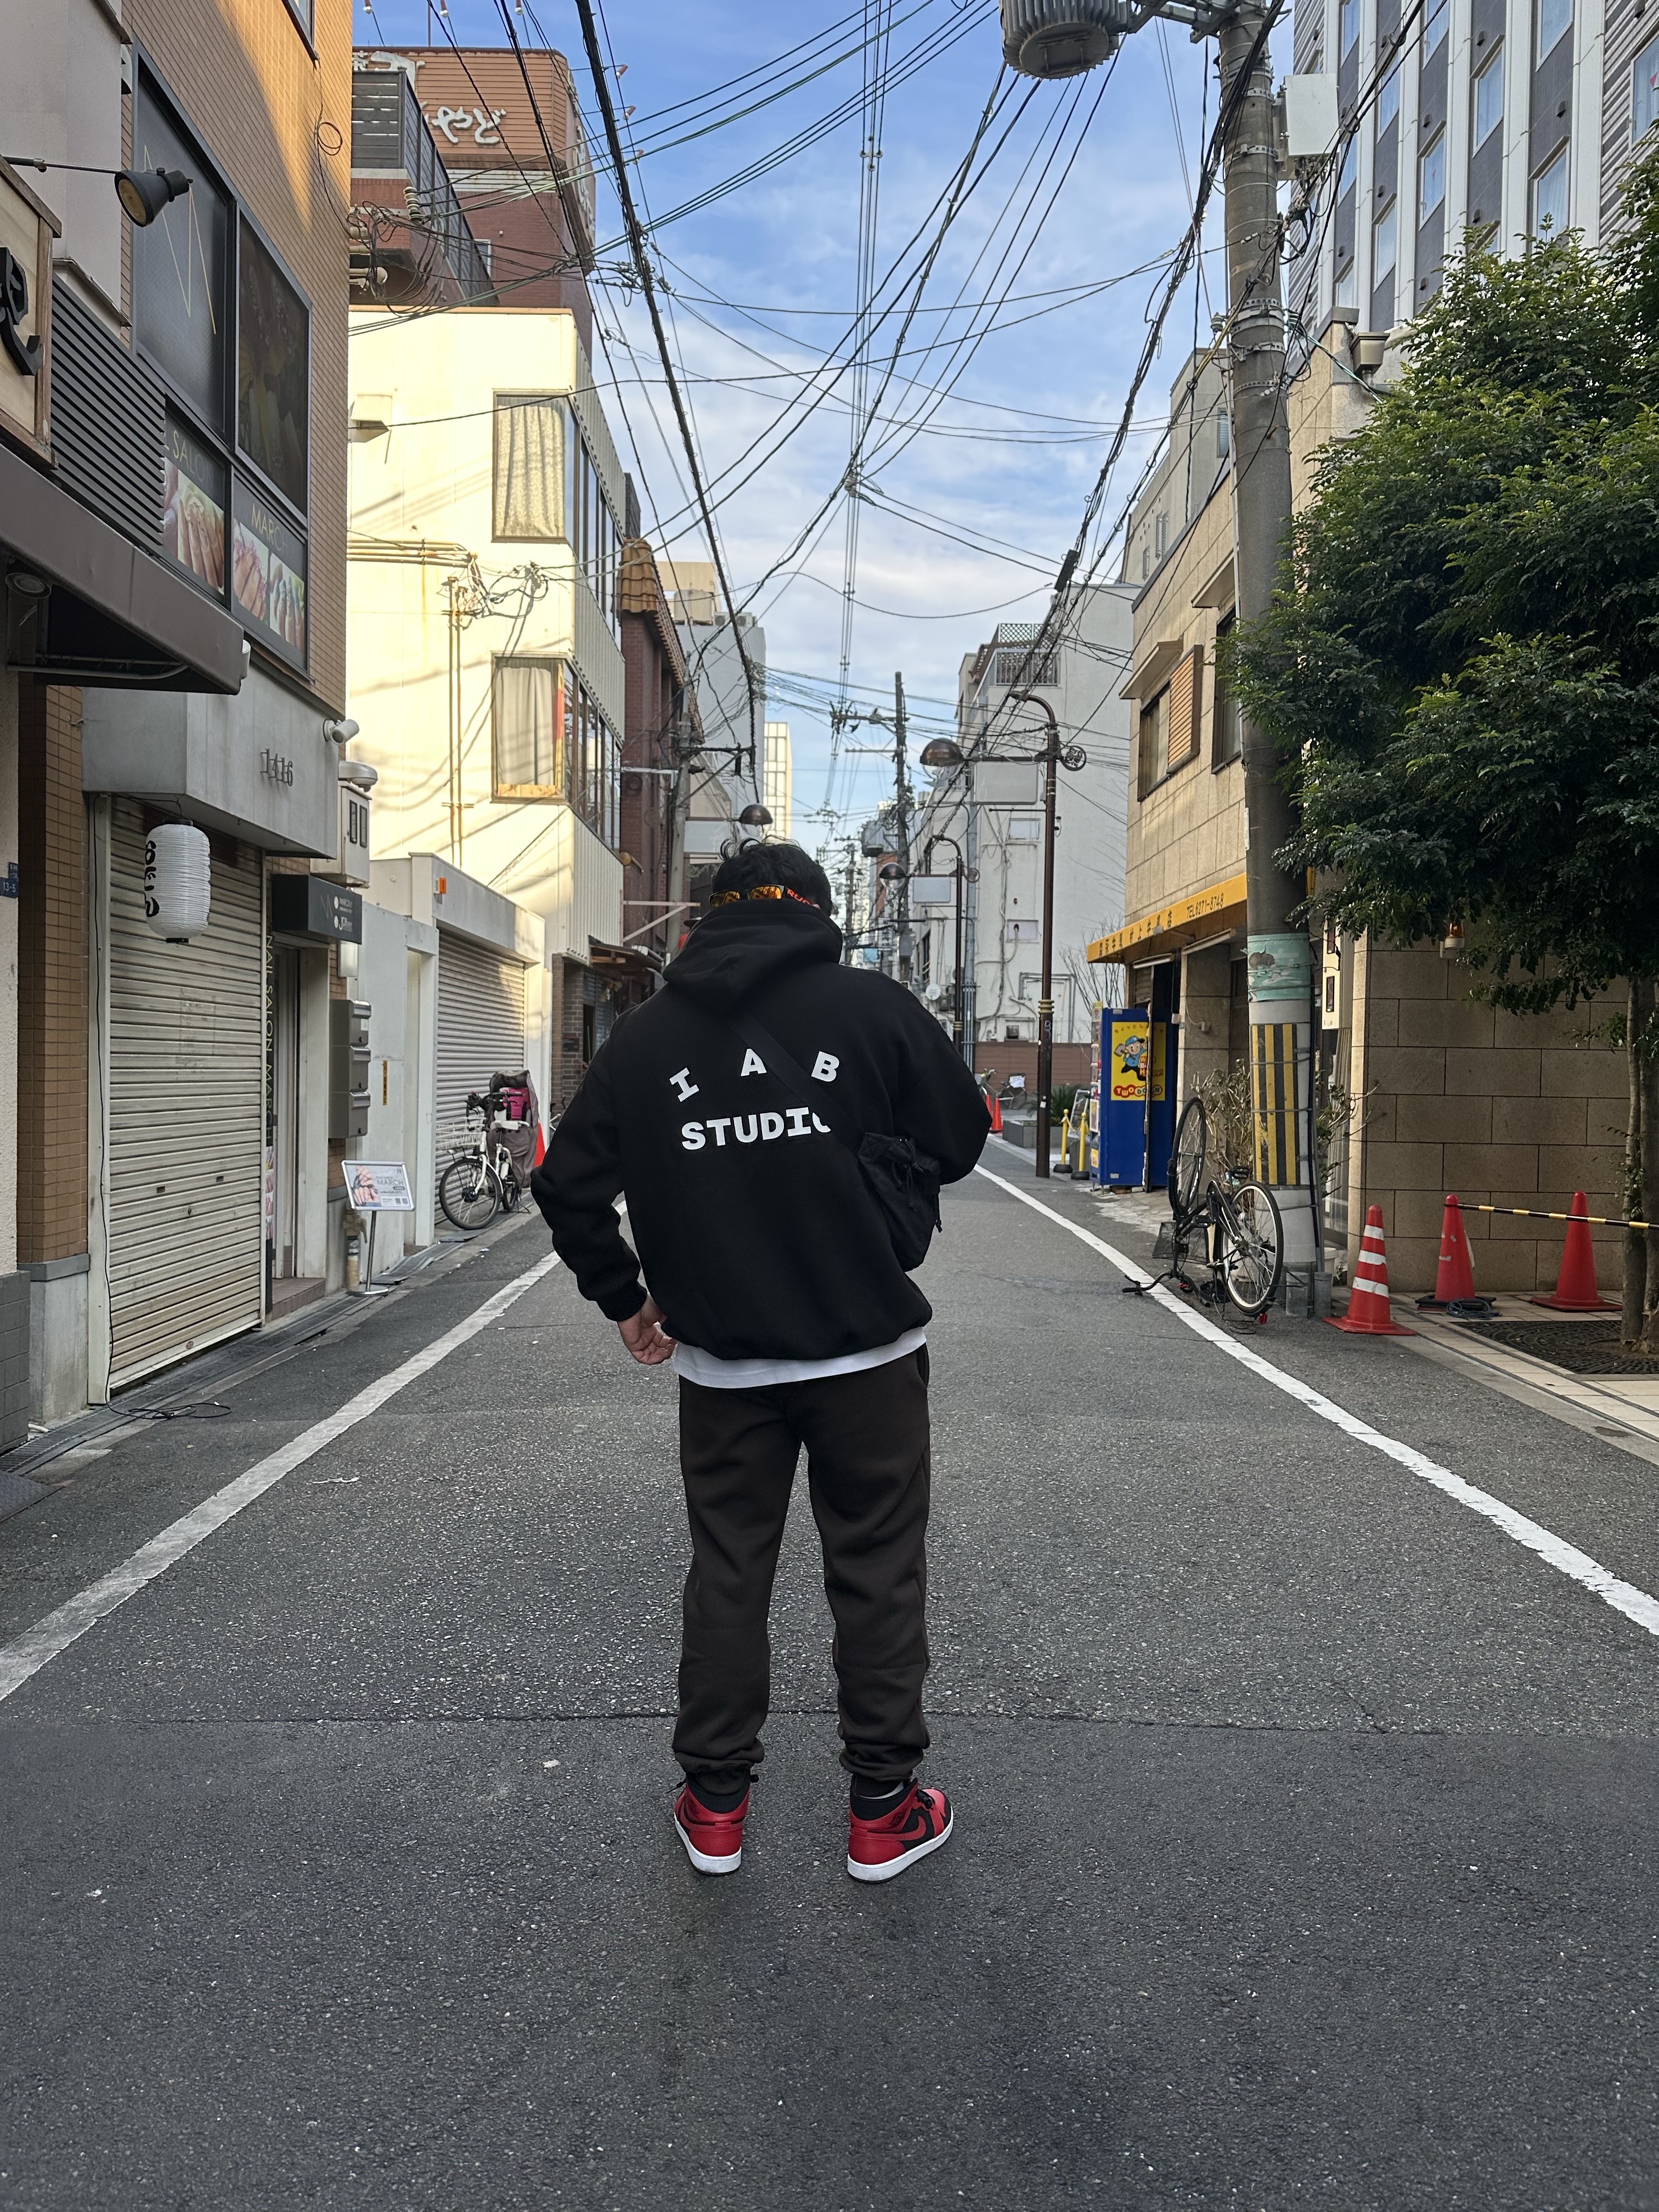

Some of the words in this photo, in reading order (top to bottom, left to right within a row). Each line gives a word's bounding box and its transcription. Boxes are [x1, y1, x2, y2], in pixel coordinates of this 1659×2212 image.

[419, 100, 507, 145] やど
[251, 503, 289, 553] MARCH
[264, 748, 294, 787] 1416
[1116, 1087, 1135, 1097] TWO
[1137, 1086, 1160, 1096] DON
